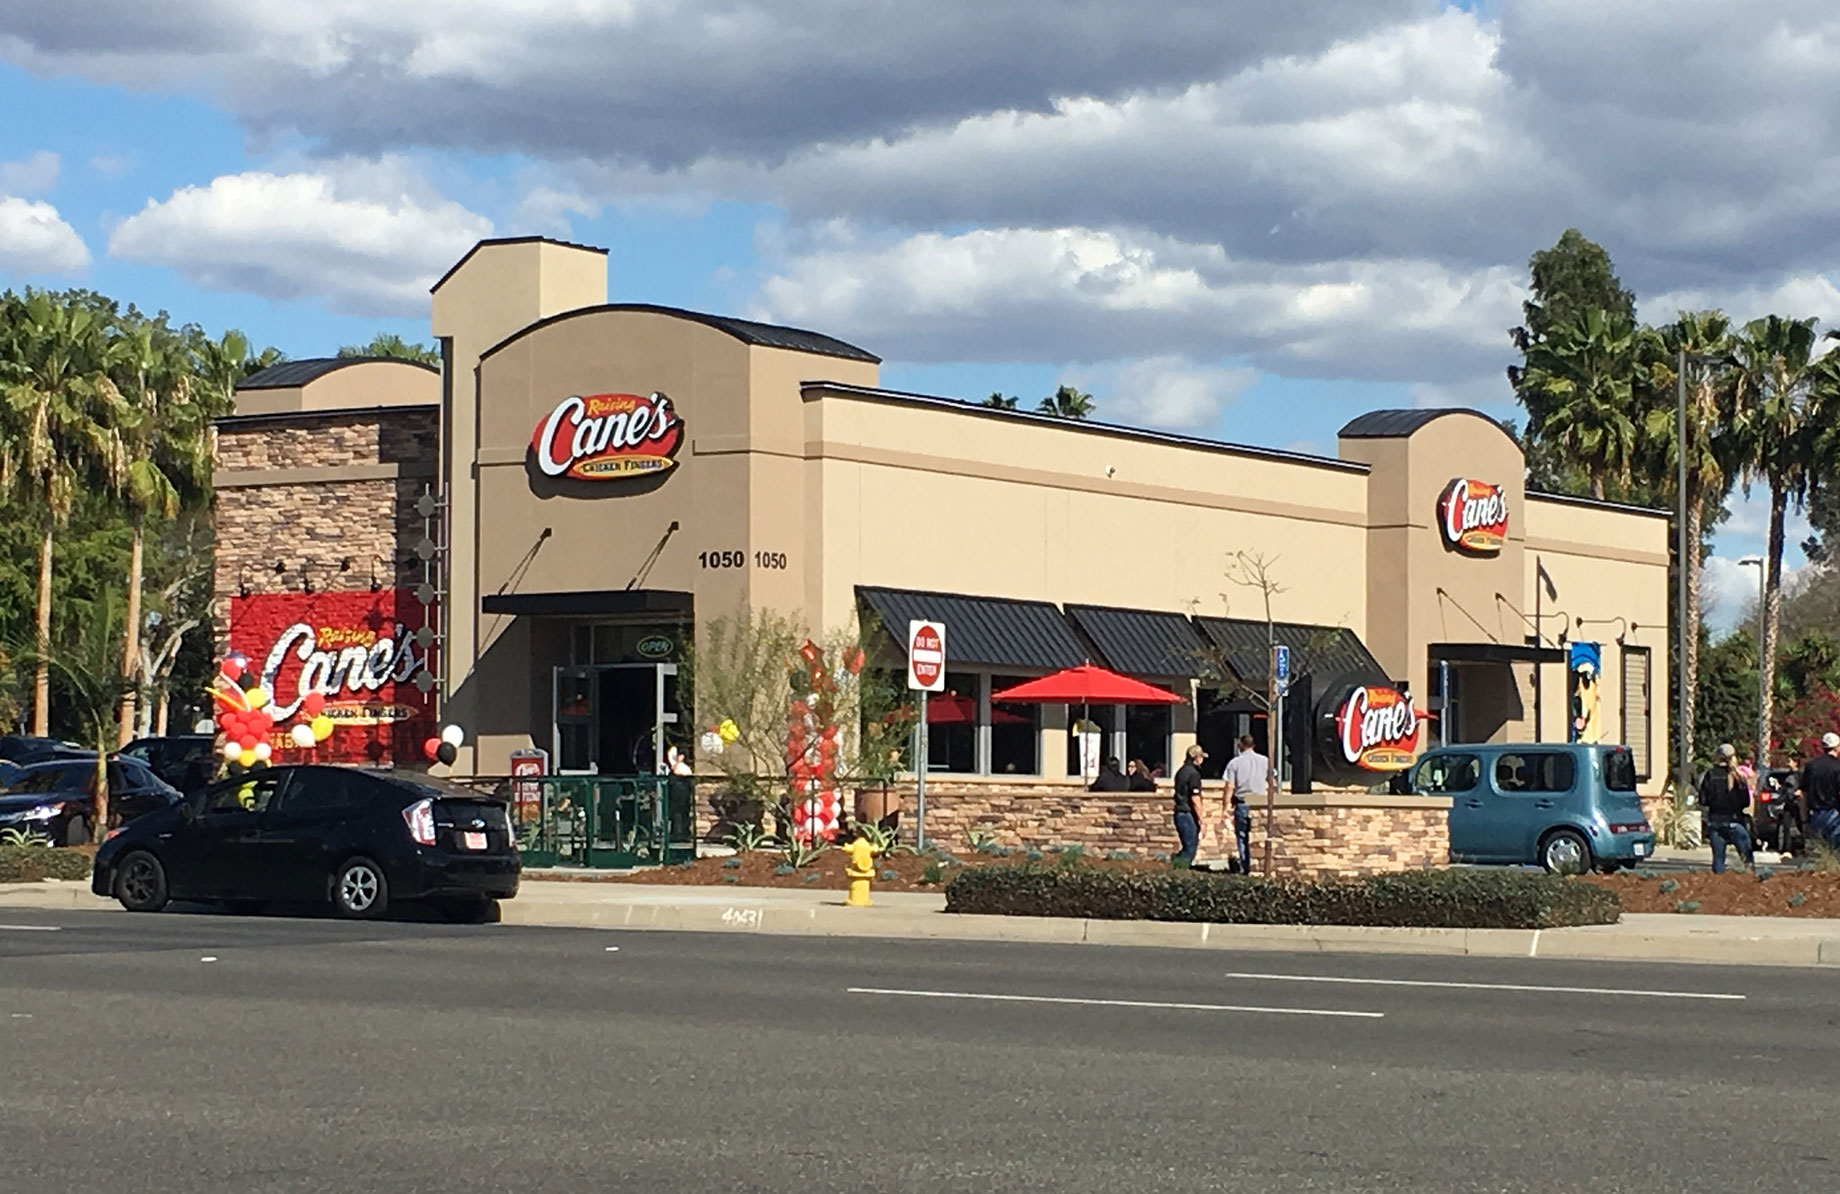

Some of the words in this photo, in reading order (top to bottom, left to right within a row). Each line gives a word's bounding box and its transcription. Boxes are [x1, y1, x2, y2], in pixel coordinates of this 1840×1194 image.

[586, 398, 636, 416] Raising
[538, 392, 675, 476] Cane's
[1447, 478, 1507, 542] Cane's
[699, 551, 744, 568] 1050
[755, 551, 787, 570] 1050
[317, 627, 376, 648] Raising
[641, 640, 669, 652] OPEN
[259, 622, 425, 722] Cane's
[1342, 686, 1420, 763] Cane's
